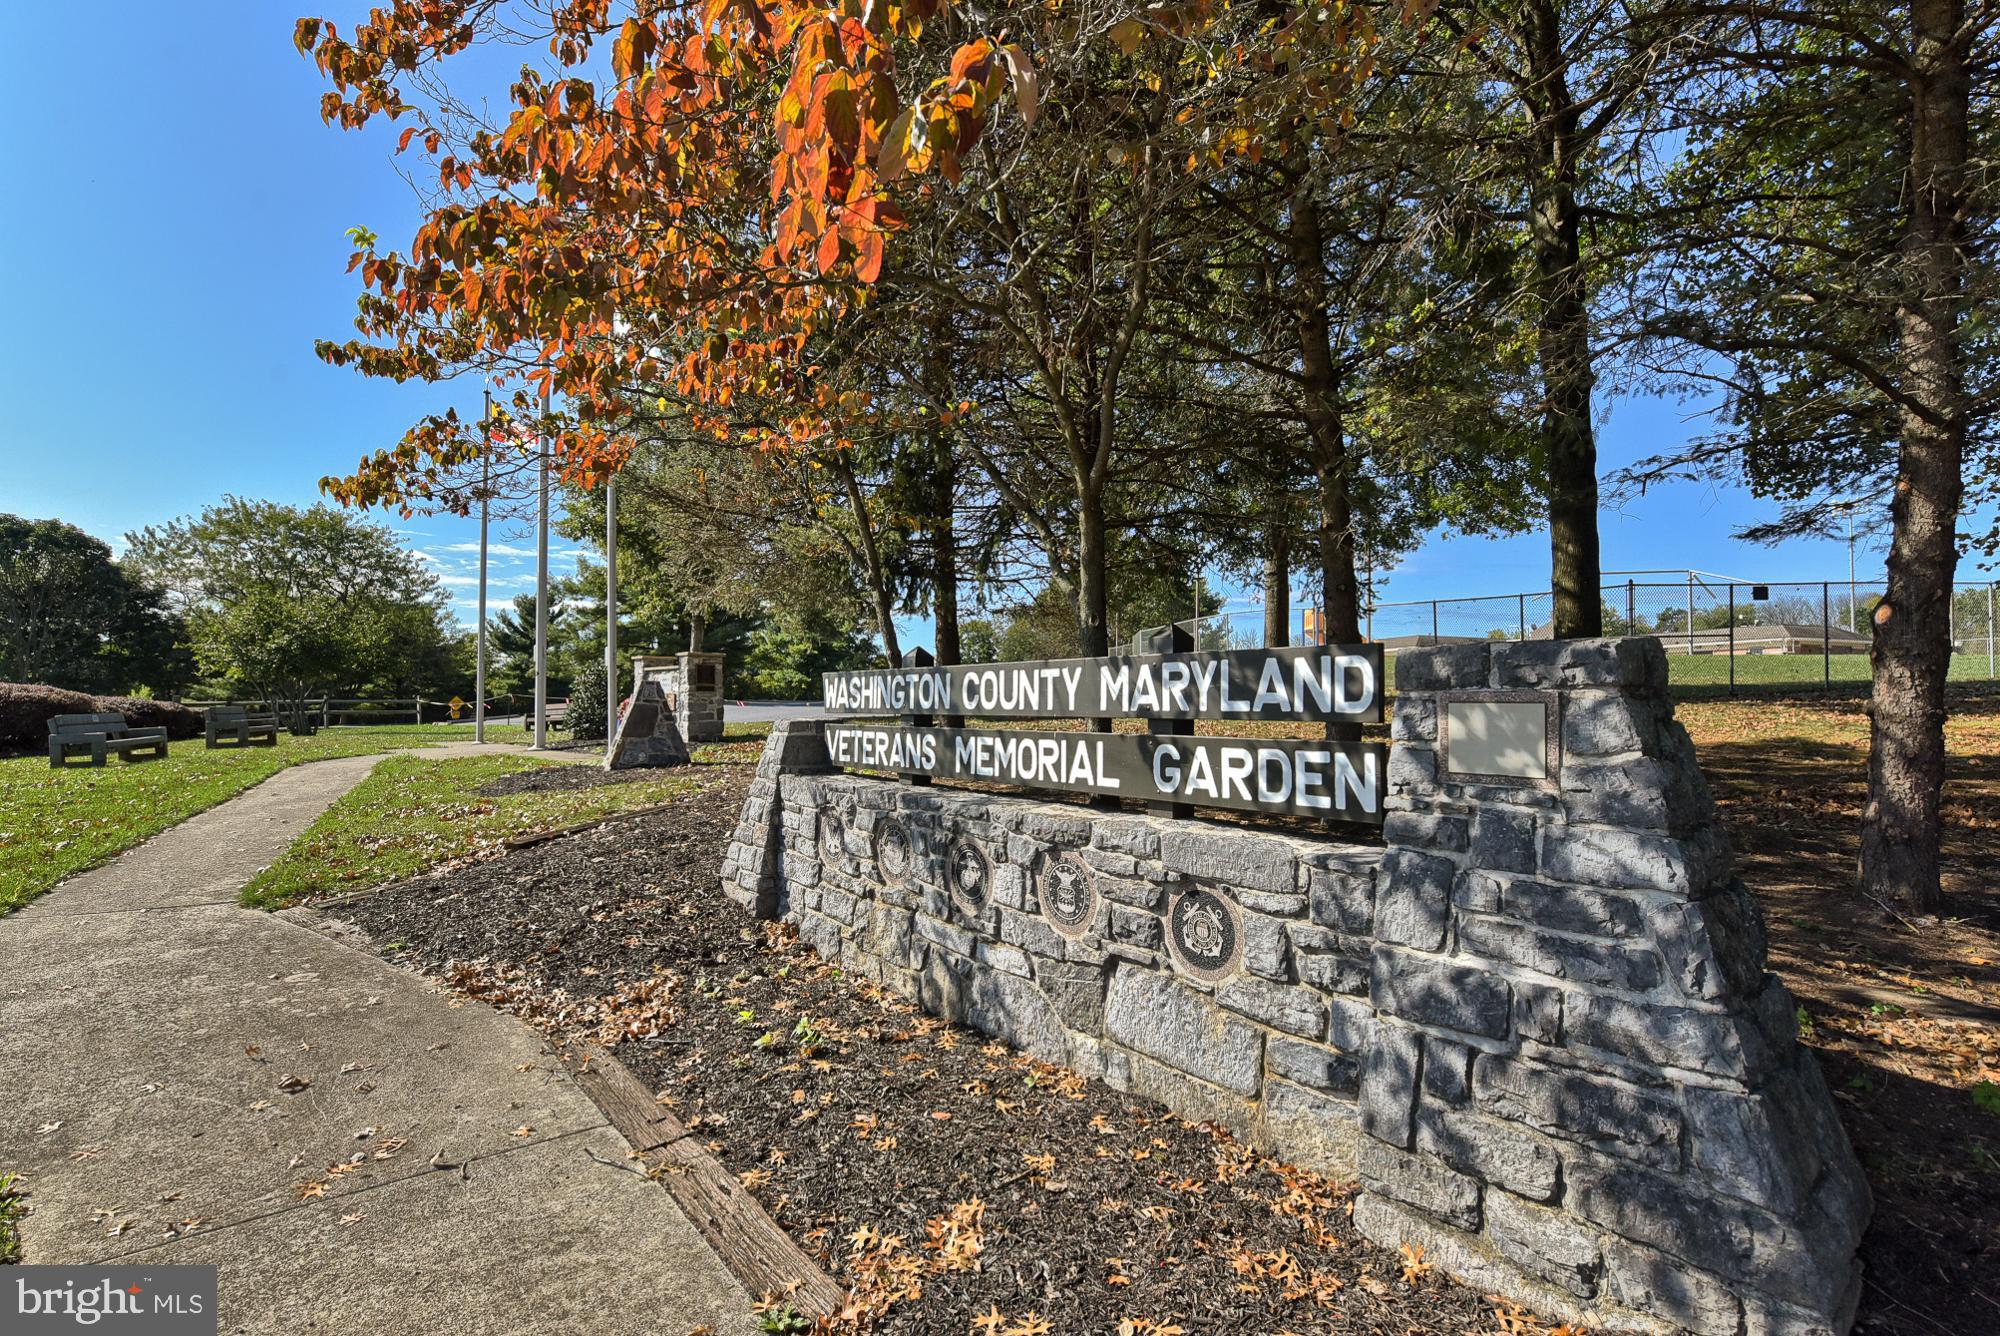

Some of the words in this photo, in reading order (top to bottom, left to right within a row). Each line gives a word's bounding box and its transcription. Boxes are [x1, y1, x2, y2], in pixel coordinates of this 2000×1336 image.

[824, 673, 952, 710] WASHINGTON
[962, 667, 1082, 711] COUNTY
[1100, 655, 1375, 714] MARYLAND
[826, 729, 937, 770] VETERANS
[955, 736, 1121, 788] MEMORIAL
[1153, 744, 1377, 813] GARDEN
